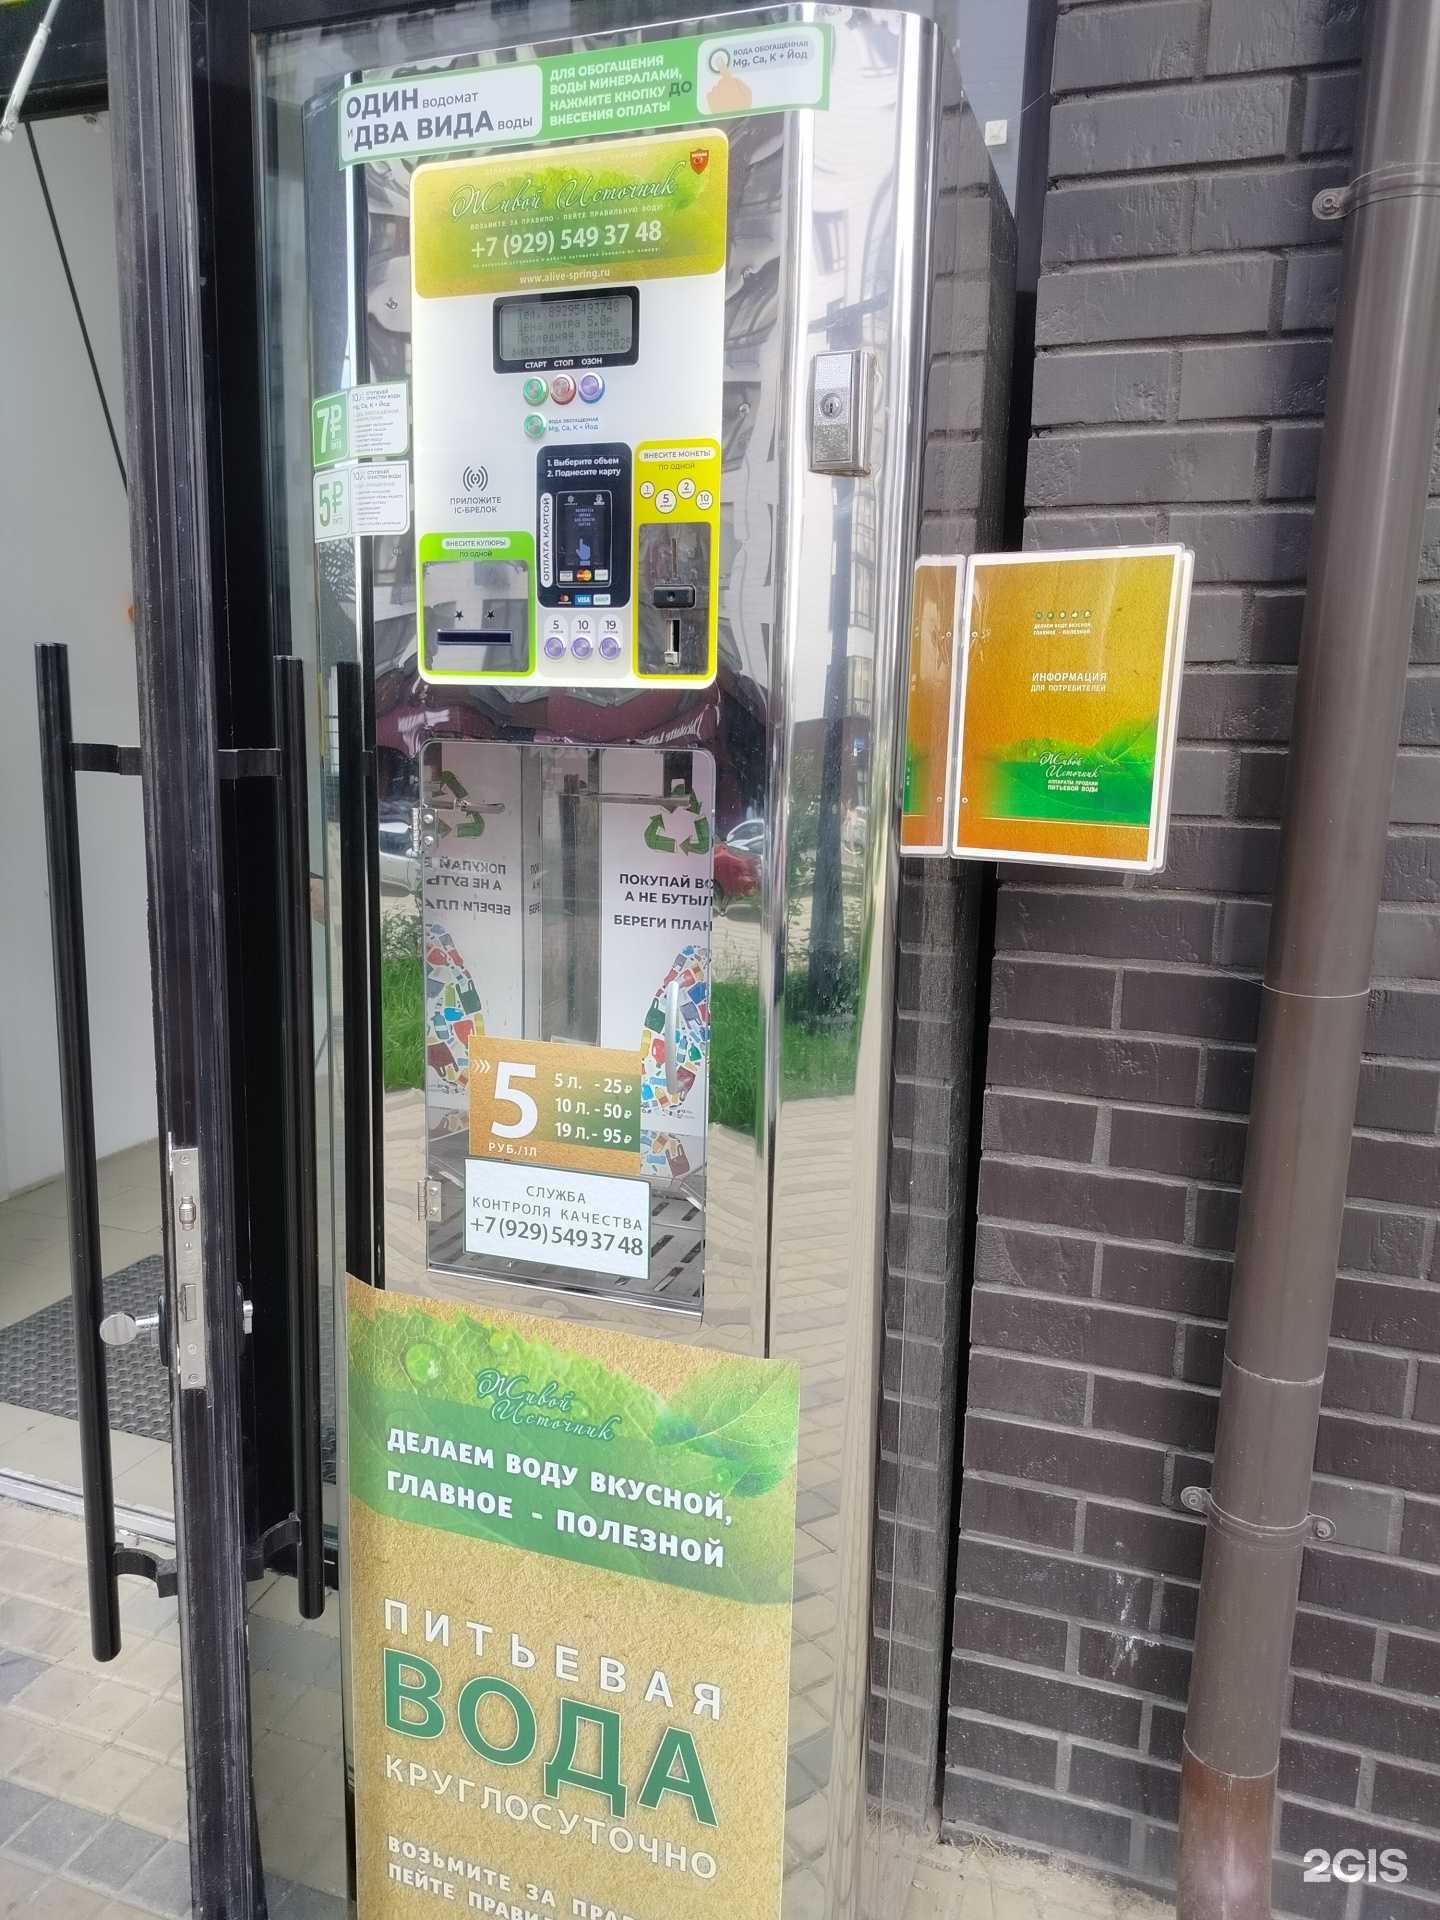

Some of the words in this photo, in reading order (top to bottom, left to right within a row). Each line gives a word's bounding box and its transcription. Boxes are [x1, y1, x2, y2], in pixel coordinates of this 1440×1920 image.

[550, 67, 576, 81] ДЛЯ
[578, 54, 664, 78] ОБОГАЩЕНИЯ
[733, 57, 750, 70] Mg,
[550, 81, 588, 95] ВОДЫ
[590, 70, 682, 91] МИНЕРАЛАМИ,
[346, 88, 418, 120] ОДИН
[422, 91, 479, 110] водомат
[550, 95, 613, 112] НАЖМИТЕ
[614, 86, 666, 106] КНОПКУ
[668, 81, 692, 98] ДО
[550, 108, 614, 127] ВНЕСЕНИЯ
[616, 101, 671, 118] ОПЛАТЫ
[354, 120, 409, 152] ДВА
[417, 110, 494, 140] ВИДА
[498, 116, 533, 130] воды
[452, 179, 545, 220] Живой
[556, 160, 686, 209] Источник
[472, 236, 498, 258] +7
[503, 230, 555, 259] (929)
[560, 226, 599, 250] 549
[604, 222, 630, 247] 37
[635, 220, 662, 243] 48
[519, 267, 610, 285] www.alive-spring.ru
[525, 360, 547, 369] СТАРТ
[554, 358, 574, 368] СТОП
[581, 357, 602, 366] ОЗОН
[554, 457, 592, 467] Выберите
[644, 451, 678, 460] ВНЕСИТЕ
[679, 450, 711, 458] МОНЕТЫ
[547, 470, 553, 478] 2.
[555, 468, 597, 478] Поднесите
[598, 468, 621, 477] карту
[684, 482, 690, 491] 2
[450, 496, 502, 505] ПРИЛОЖИТЕ
[663, 493, 670, 504] 5
[700, 494, 709, 502] 10
[552, 620, 559, 630] 5
[577, 620, 589, 630] 10
[606, 620, 616, 630] 19
[1031, 672, 1107, 683] ИНФОРМАЦИЯ
[1048, 684, 1106, 692] ПОТРЕБИТЕЛЕЙ
[619, 873, 690, 889] ПОКУПАЙ
[625, 891, 634, 902] А
[639, 892, 657, 903] НЕ
[614, 914, 667, 929] БЕРЕГИ
[553, 1072, 563, 1088] 5
[490, 1061, 538, 1140] 5
[555, 1098, 571, 1113] 10
[555, 1122, 571, 1138] 19
[526, 1184, 586, 1204] СЛУЖБА
[472, 1197, 552, 1218] КОНТРОЛЯ
[560, 1208, 643, 1231] КАЧЕСТВА
[476, 1369, 575, 1413] Живой
[490, 1399, 622, 1441] Источник
[387, 1428, 494, 1469] ДЕЛАЕМ
[506, 1453, 579, 1489] ВОДУ
[590, 1471, 733, 1526] ВКУСНОЙ,
[387, 1470, 513, 1519] ГЛАВНОЕ
[557, 1508, 724, 1568] ПОЛЕЗНОЙ
[383, 1598, 722, 1720] ПИТЬЕВАЯ
[383, 1647, 720, 1829] ВОДА
[385, 1753, 718, 1880] КРУГЛОСУТОЧНО
[388, 1835, 511, 1893] ВОЗЬМИТЕ
[525, 1883, 556, 1908] ЗА
[388, 1862, 455, 1900] ПЕЙТЕ
